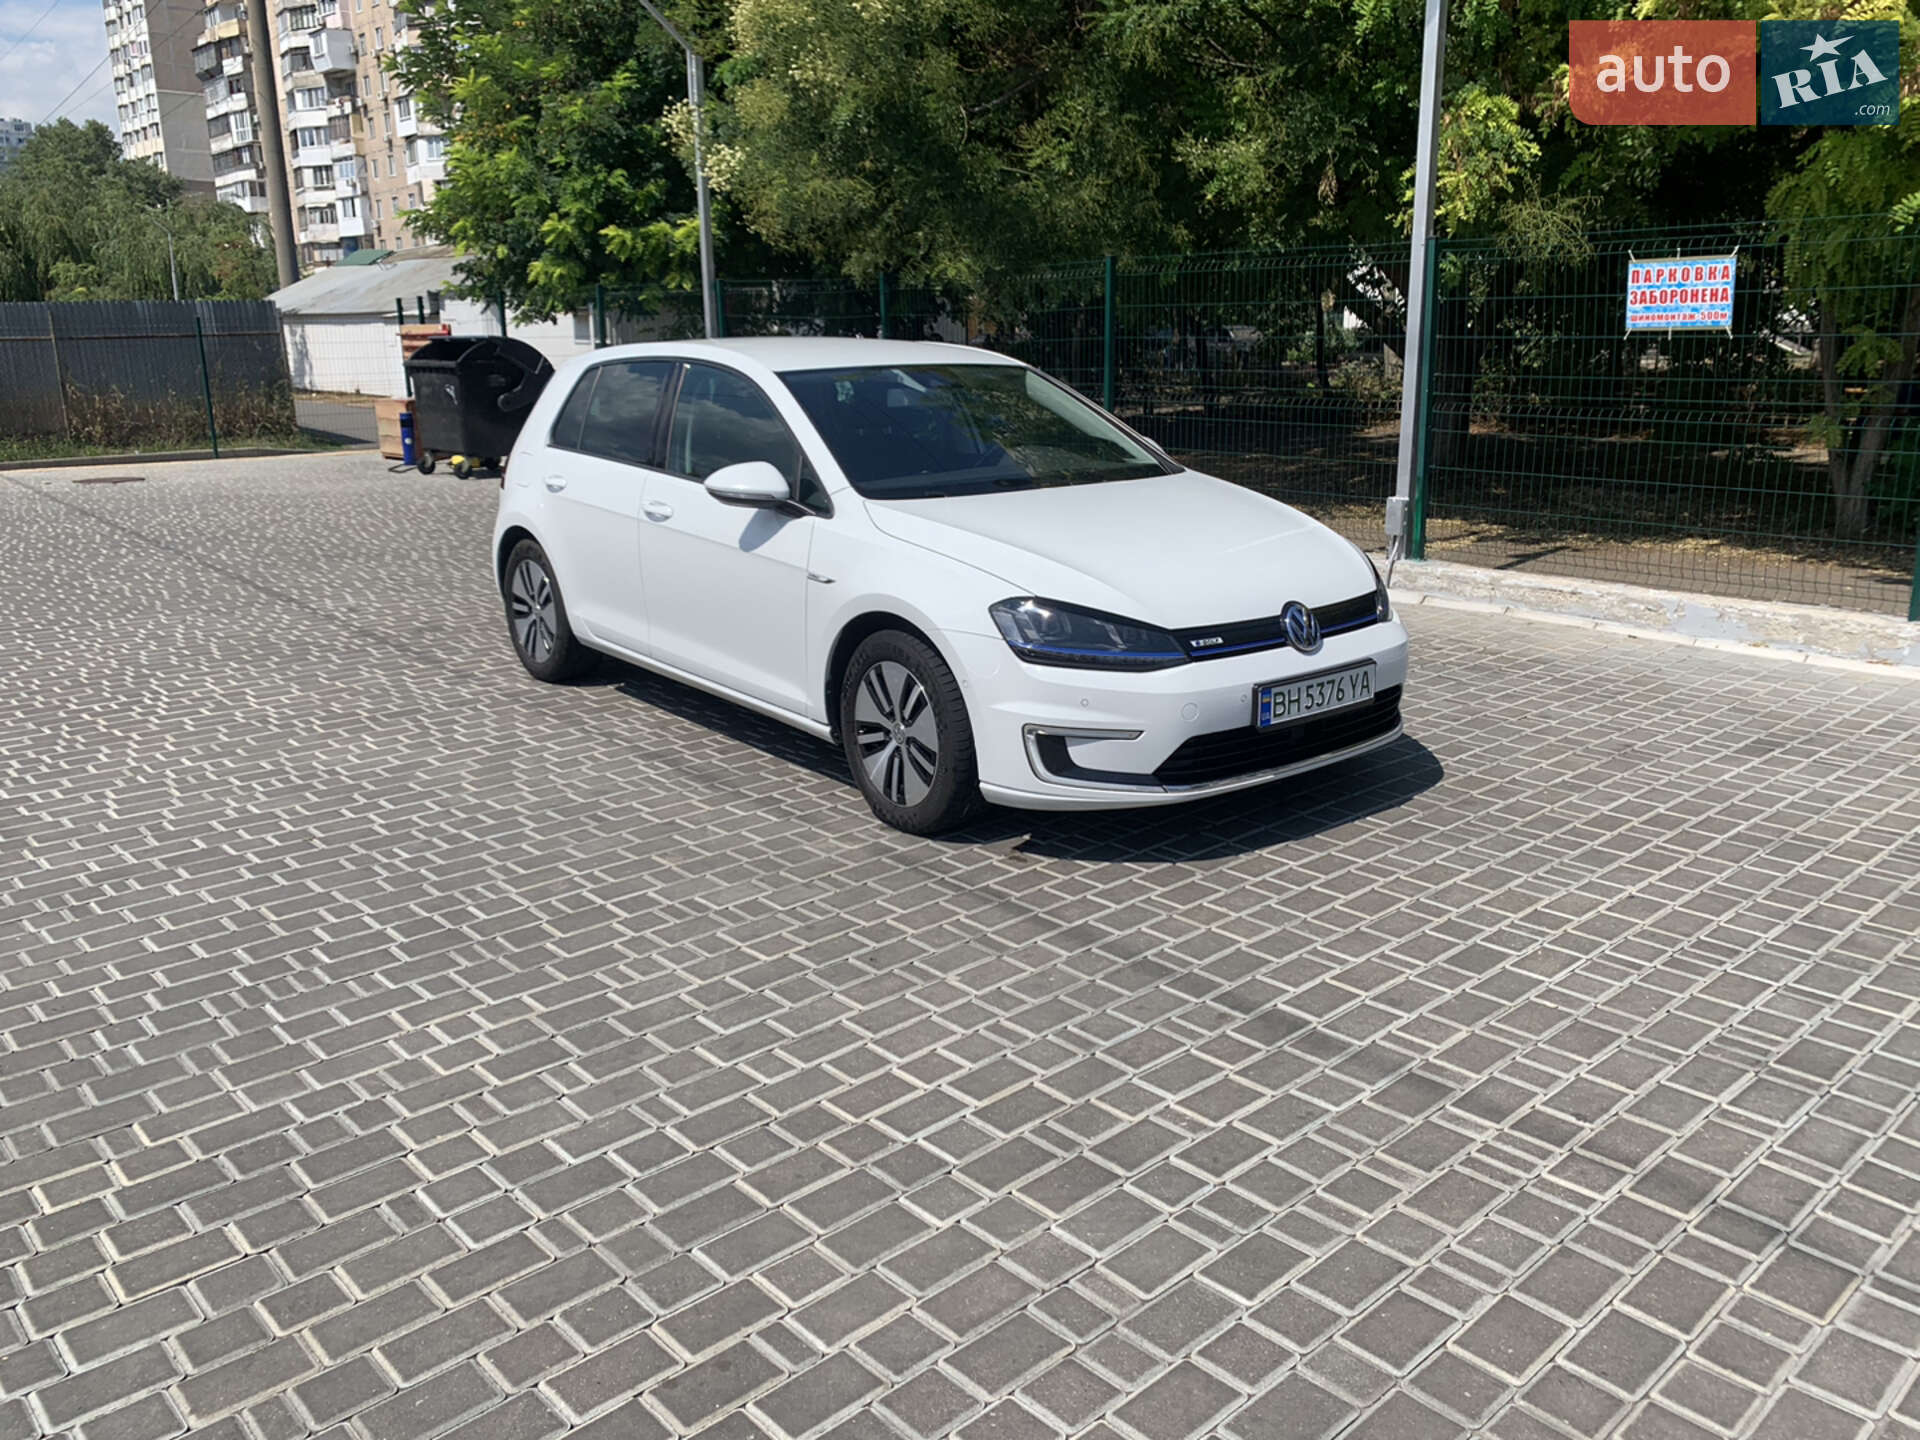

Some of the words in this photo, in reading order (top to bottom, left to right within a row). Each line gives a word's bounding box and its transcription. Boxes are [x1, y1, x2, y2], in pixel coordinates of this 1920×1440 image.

[1631, 265, 1730, 284] ПАРКОВКА
[1630, 287, 1729, 305] ЗАБОРОНЕНА
[1273, 687, 1301, 718] BH
[1304, 676, 1345, 710] 5376
[1350, 671, 1370, 699] YA
